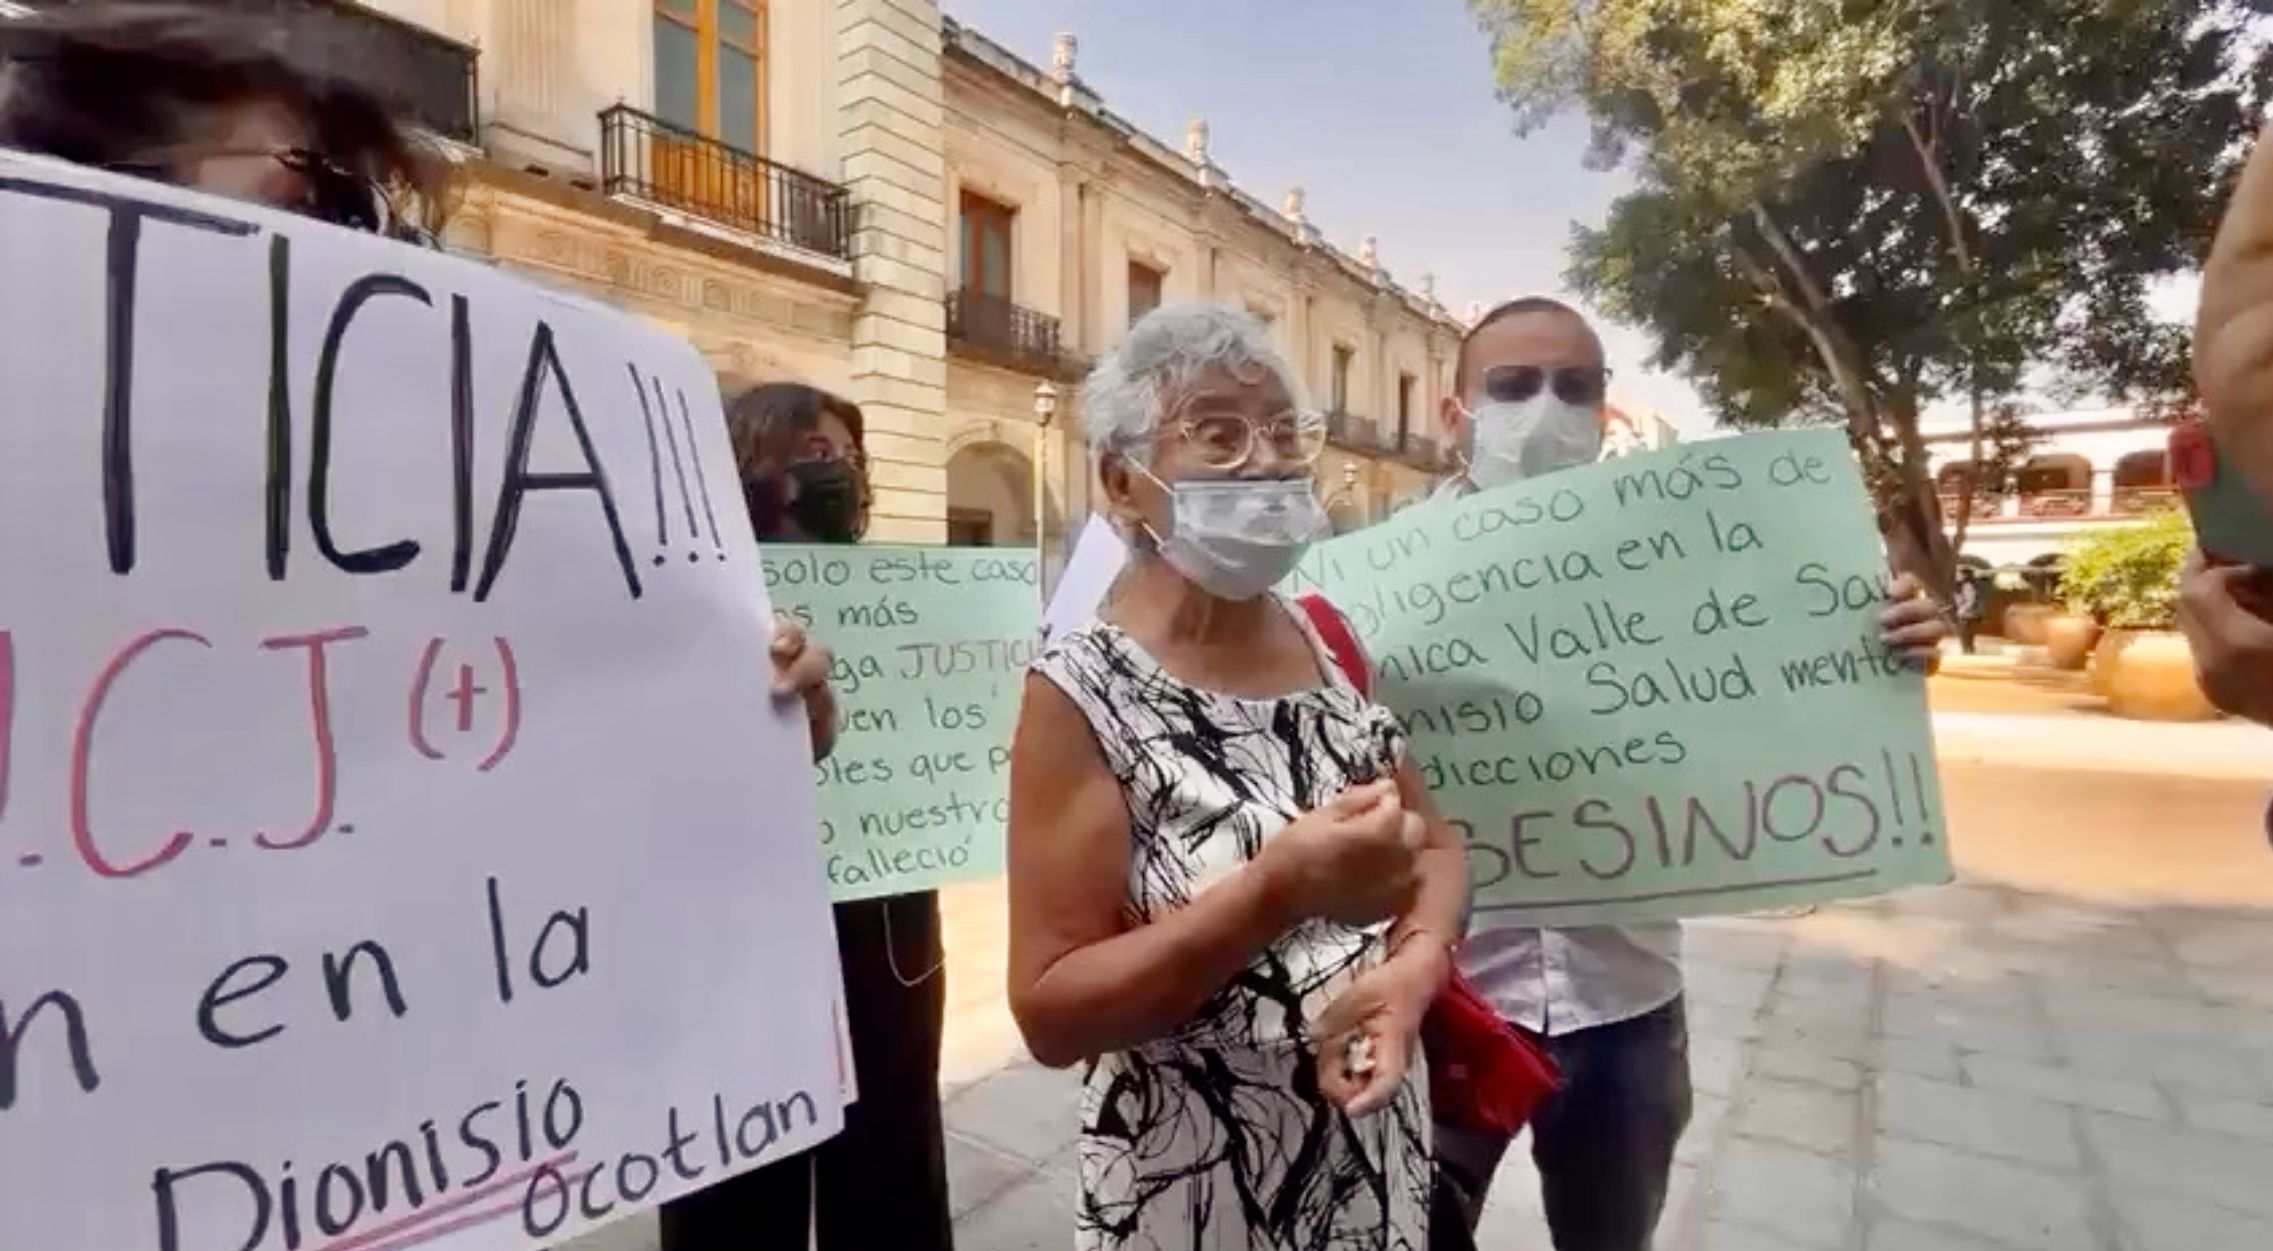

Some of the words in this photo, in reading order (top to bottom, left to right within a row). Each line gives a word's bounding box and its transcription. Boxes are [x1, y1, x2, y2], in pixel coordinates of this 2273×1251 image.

[1366, 528, 1431, 571] un
[1453, 489, 1584, 541] caso
[1614, 453, 1742, 505] más
[1770, 450, 1831, 486] de
[1617, 530, 1686, 570] en
[1706, 509, 1764, 552] la
[762, 552, 850, 587] solo
[869, 551, 960, 585] este
[838, 595, 917, 628] más
[1380, 638, 1488, 681] nica
[1505, 597, 1663, 664] Valle
[1693, 587, 1769, 635] de
[926, 696, 987, 730] los
[1586, 653, 1756, 716] Salud
[910, 752, 976, 785] que
[827, 835, 971, 884] falleció
[198, 939, 408, 1048] en
[487, 877, 590, 1002] la
[152, 1078, 583, 1251] Dionisio
